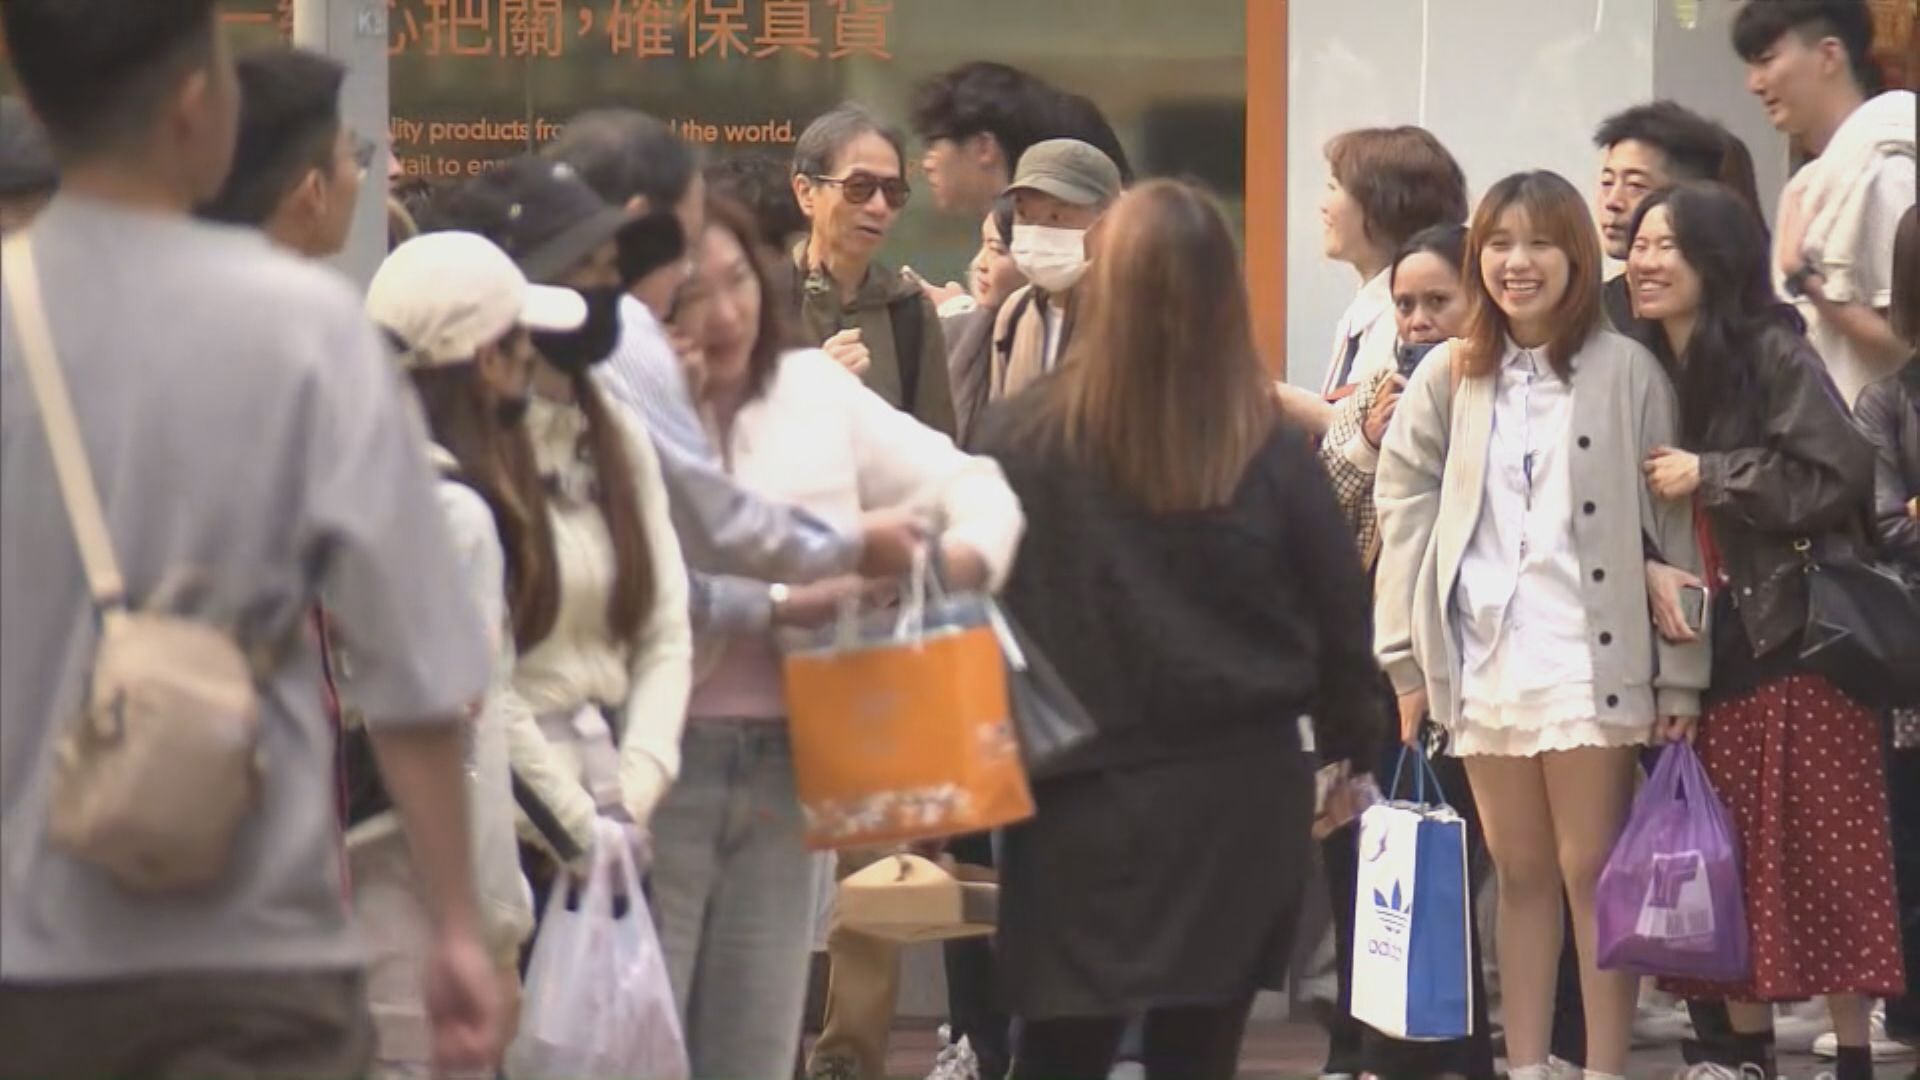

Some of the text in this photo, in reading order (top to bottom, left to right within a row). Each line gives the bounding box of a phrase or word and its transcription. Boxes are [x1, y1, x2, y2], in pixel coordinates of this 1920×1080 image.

[391, 117, 424, 145] lity
[429, 118, 530, 144] products
[682, 119, 718, 142] the
[726, 119, 797, 142] world.
[437, 157, 461, 177] to
